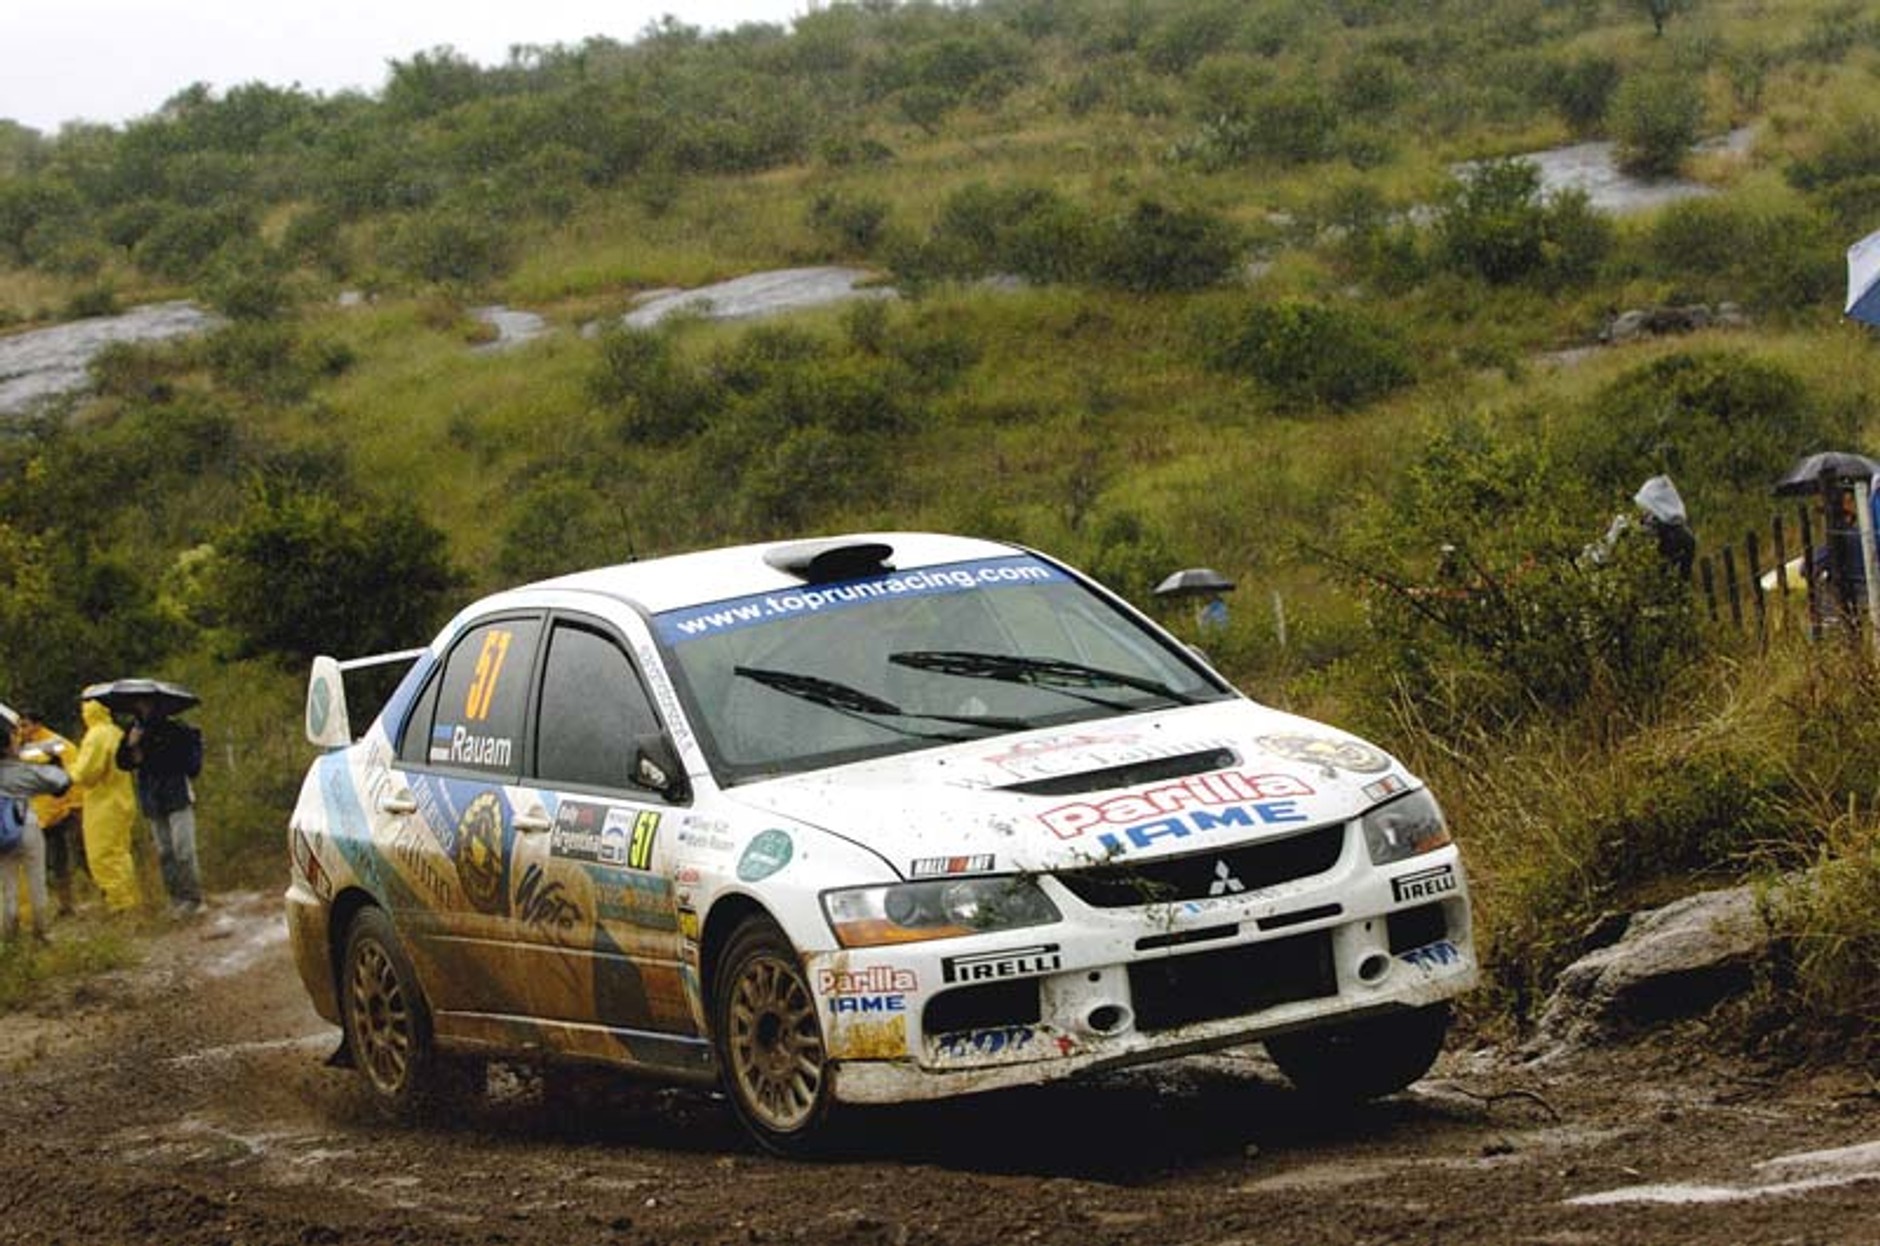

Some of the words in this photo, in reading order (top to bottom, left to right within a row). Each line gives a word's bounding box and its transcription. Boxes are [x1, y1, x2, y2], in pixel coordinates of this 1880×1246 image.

[677, 565, 1050, 634] www.toprunracing.com
[466, 629, 513, 721] 57
[452, 726, 512, 767] Rauam
[1037, 771, 1316, 840] Parilla
[1098, 801, 1308, 850] IAME
[631, 810, 660, 869] 57
[1391, 865, 1457, 903] PIRELLI
[818, 965, 918, 996] Parilla
[940, 943, 1061, 984] PIRELLI
[829, 994, 907, 1013] IAME
